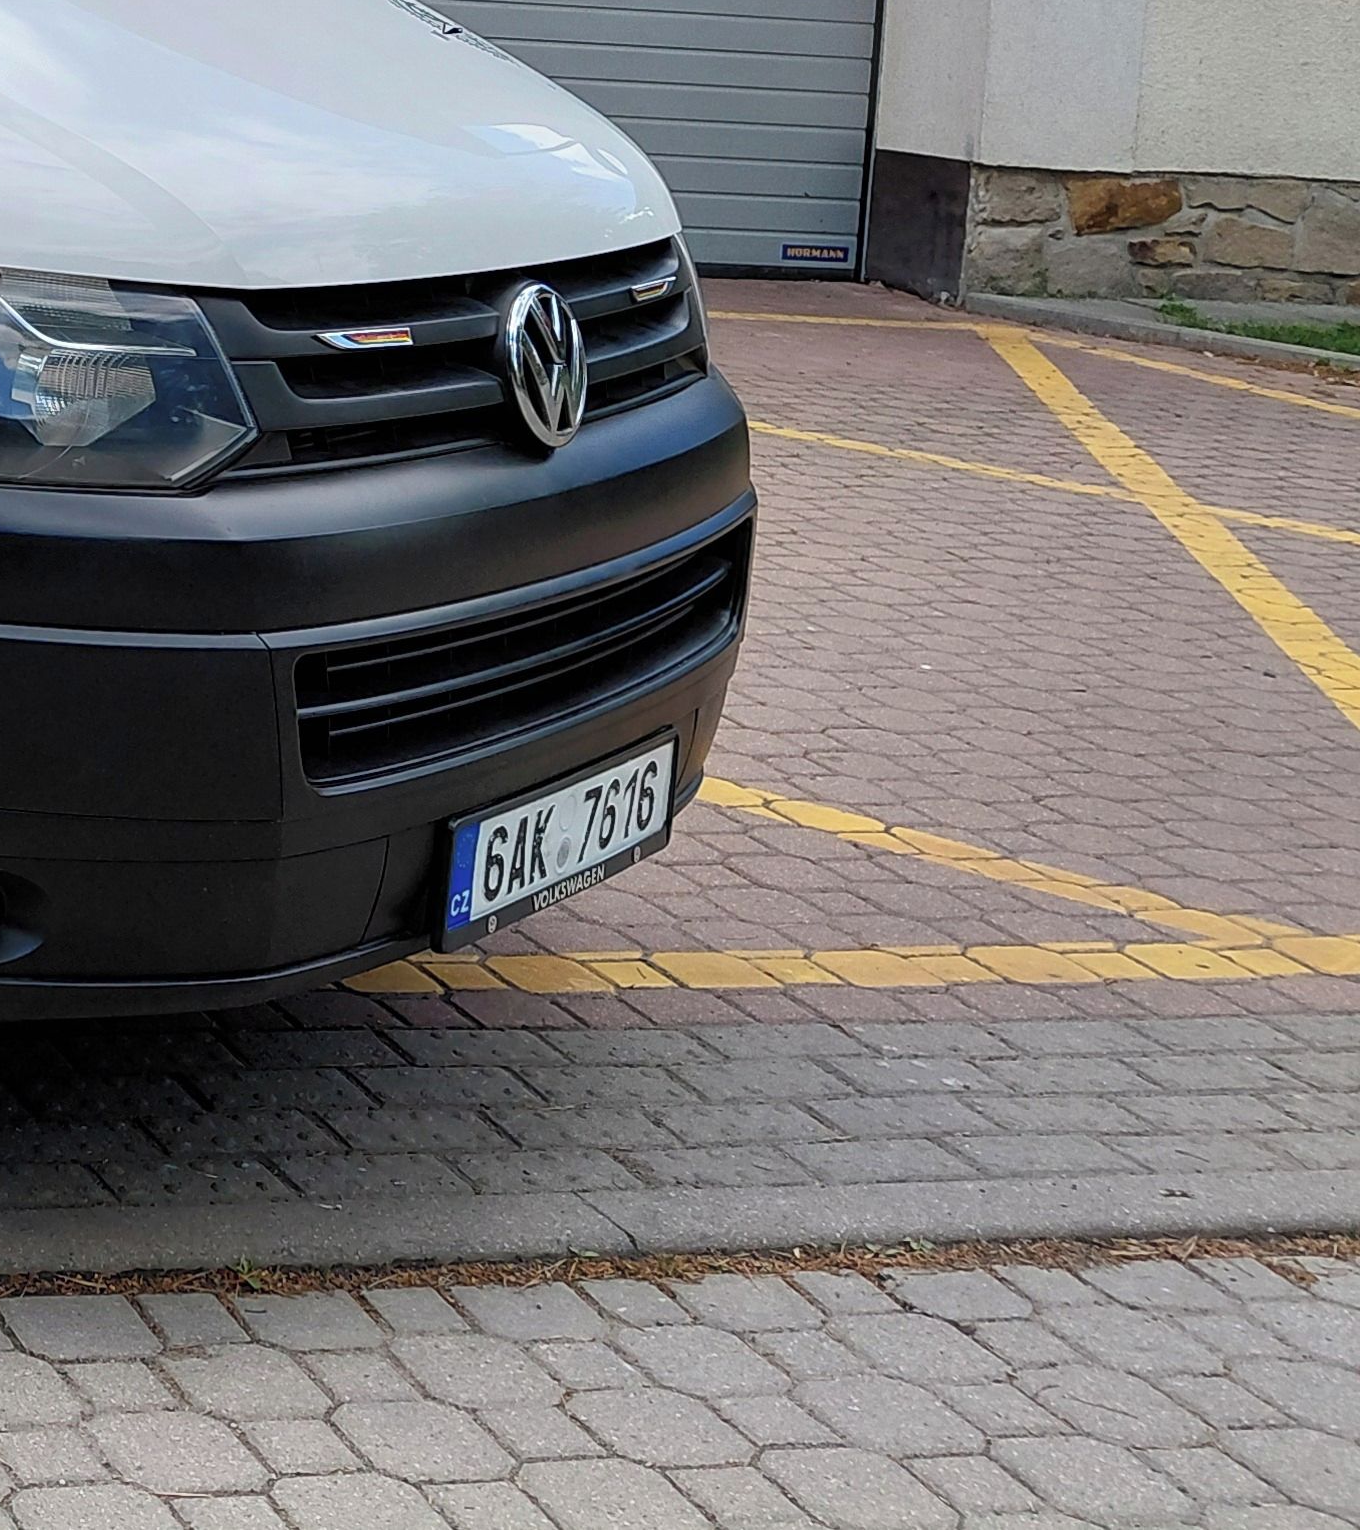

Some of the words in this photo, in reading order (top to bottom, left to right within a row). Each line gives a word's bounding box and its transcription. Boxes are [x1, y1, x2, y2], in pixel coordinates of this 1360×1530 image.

[484, 805, 555, 902] 6AK
[577, 760, 658, 864] 7616
[450, 889, 470, 917] CZ
[533, 864, 605, 911] VOLKSWAGEN
